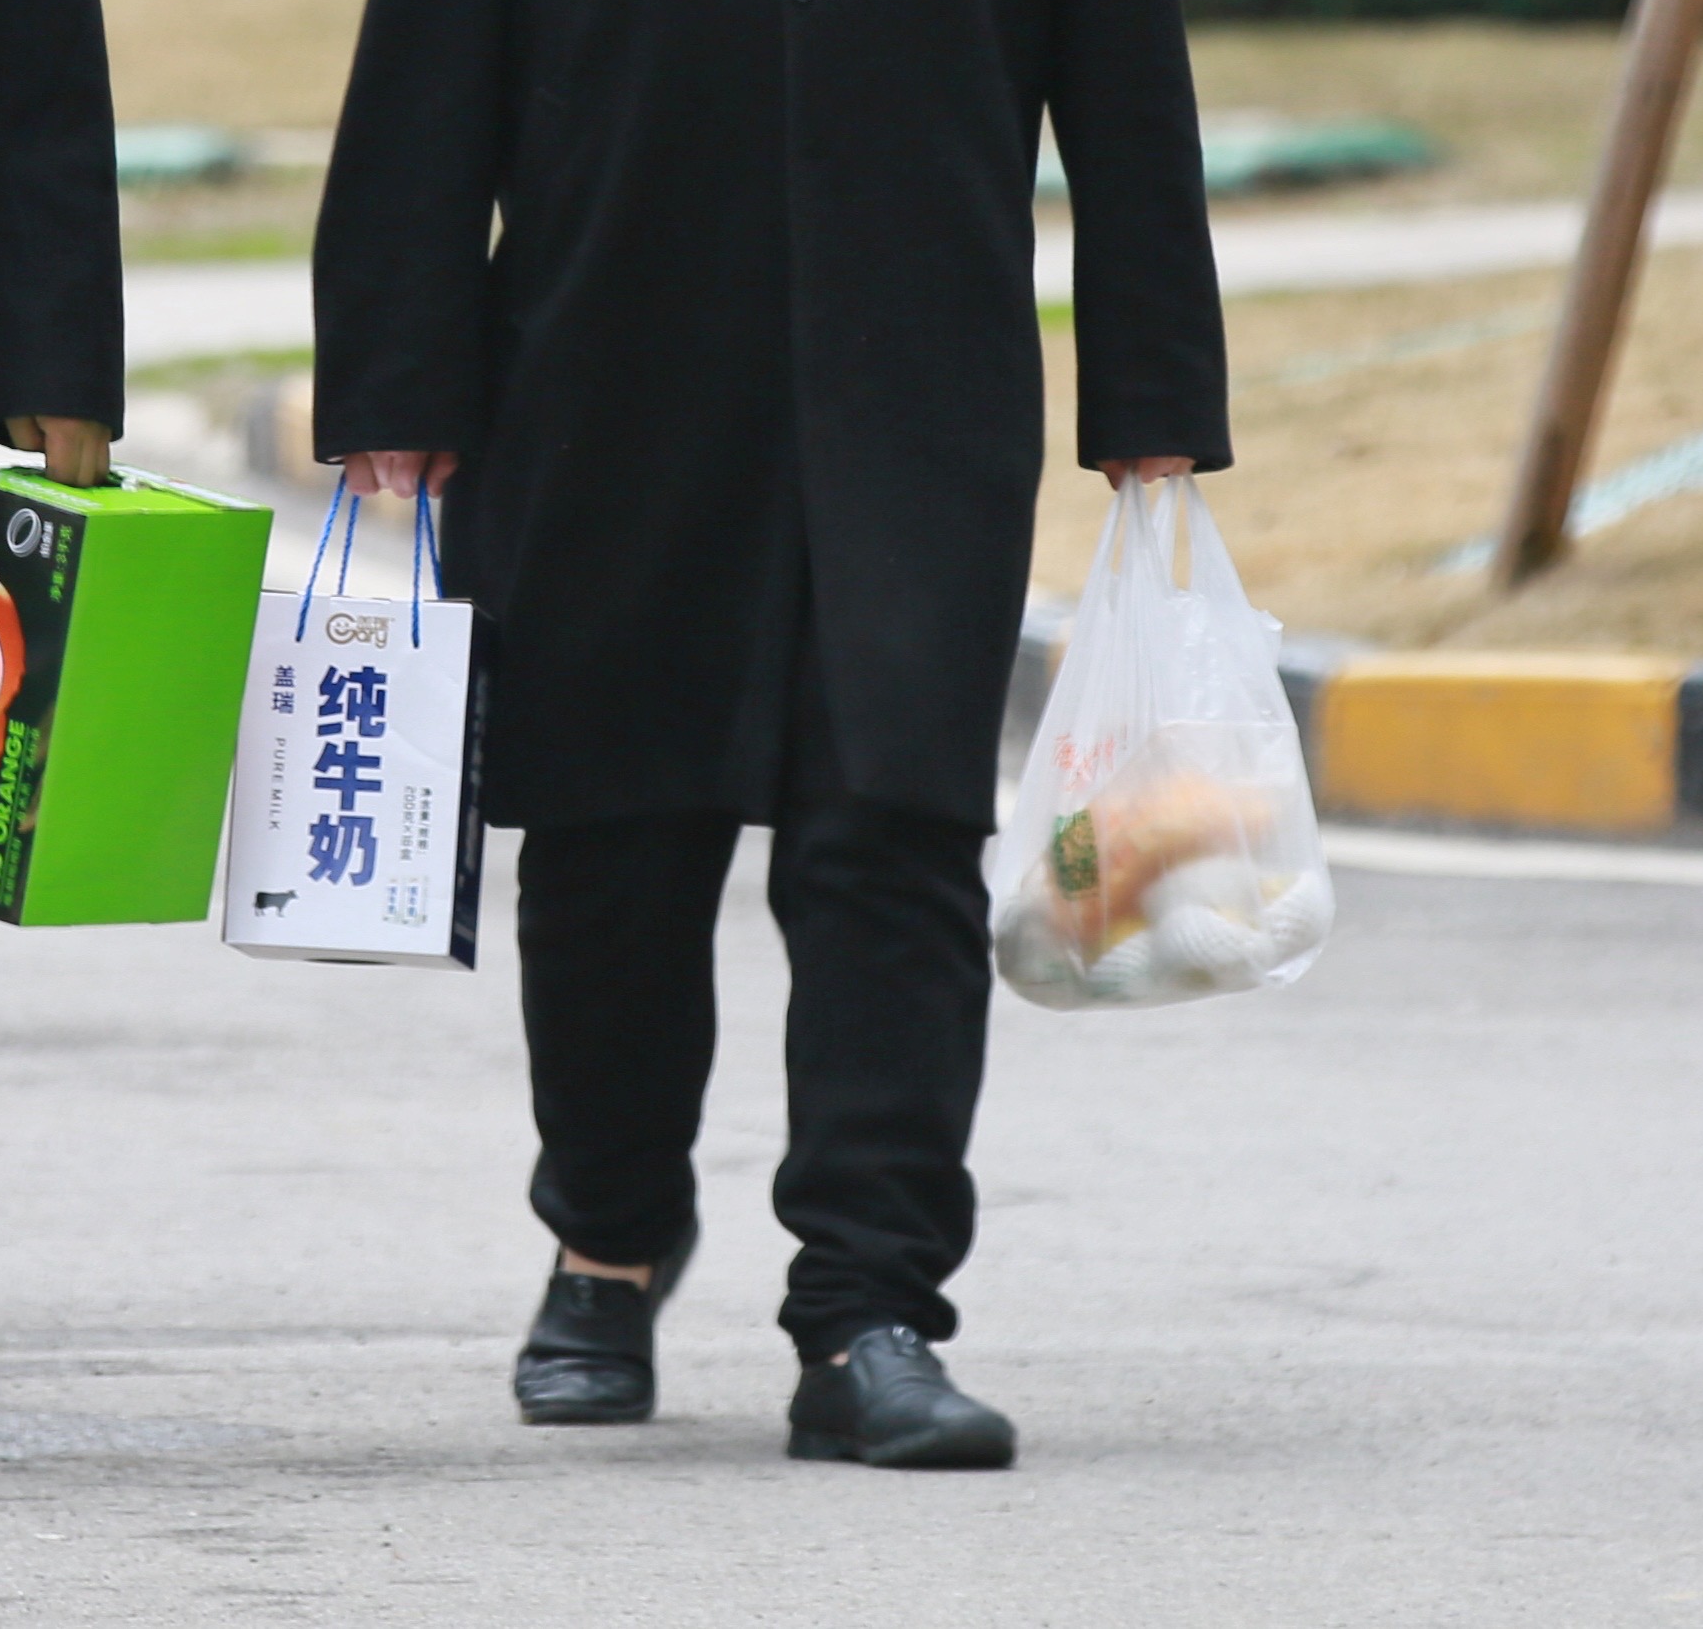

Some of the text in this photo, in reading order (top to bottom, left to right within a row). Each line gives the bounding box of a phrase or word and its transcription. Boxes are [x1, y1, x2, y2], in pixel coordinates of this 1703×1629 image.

[270, 737, 286, 830] PURE MILK
[307, 665, 388, 886] 纯牛奶
